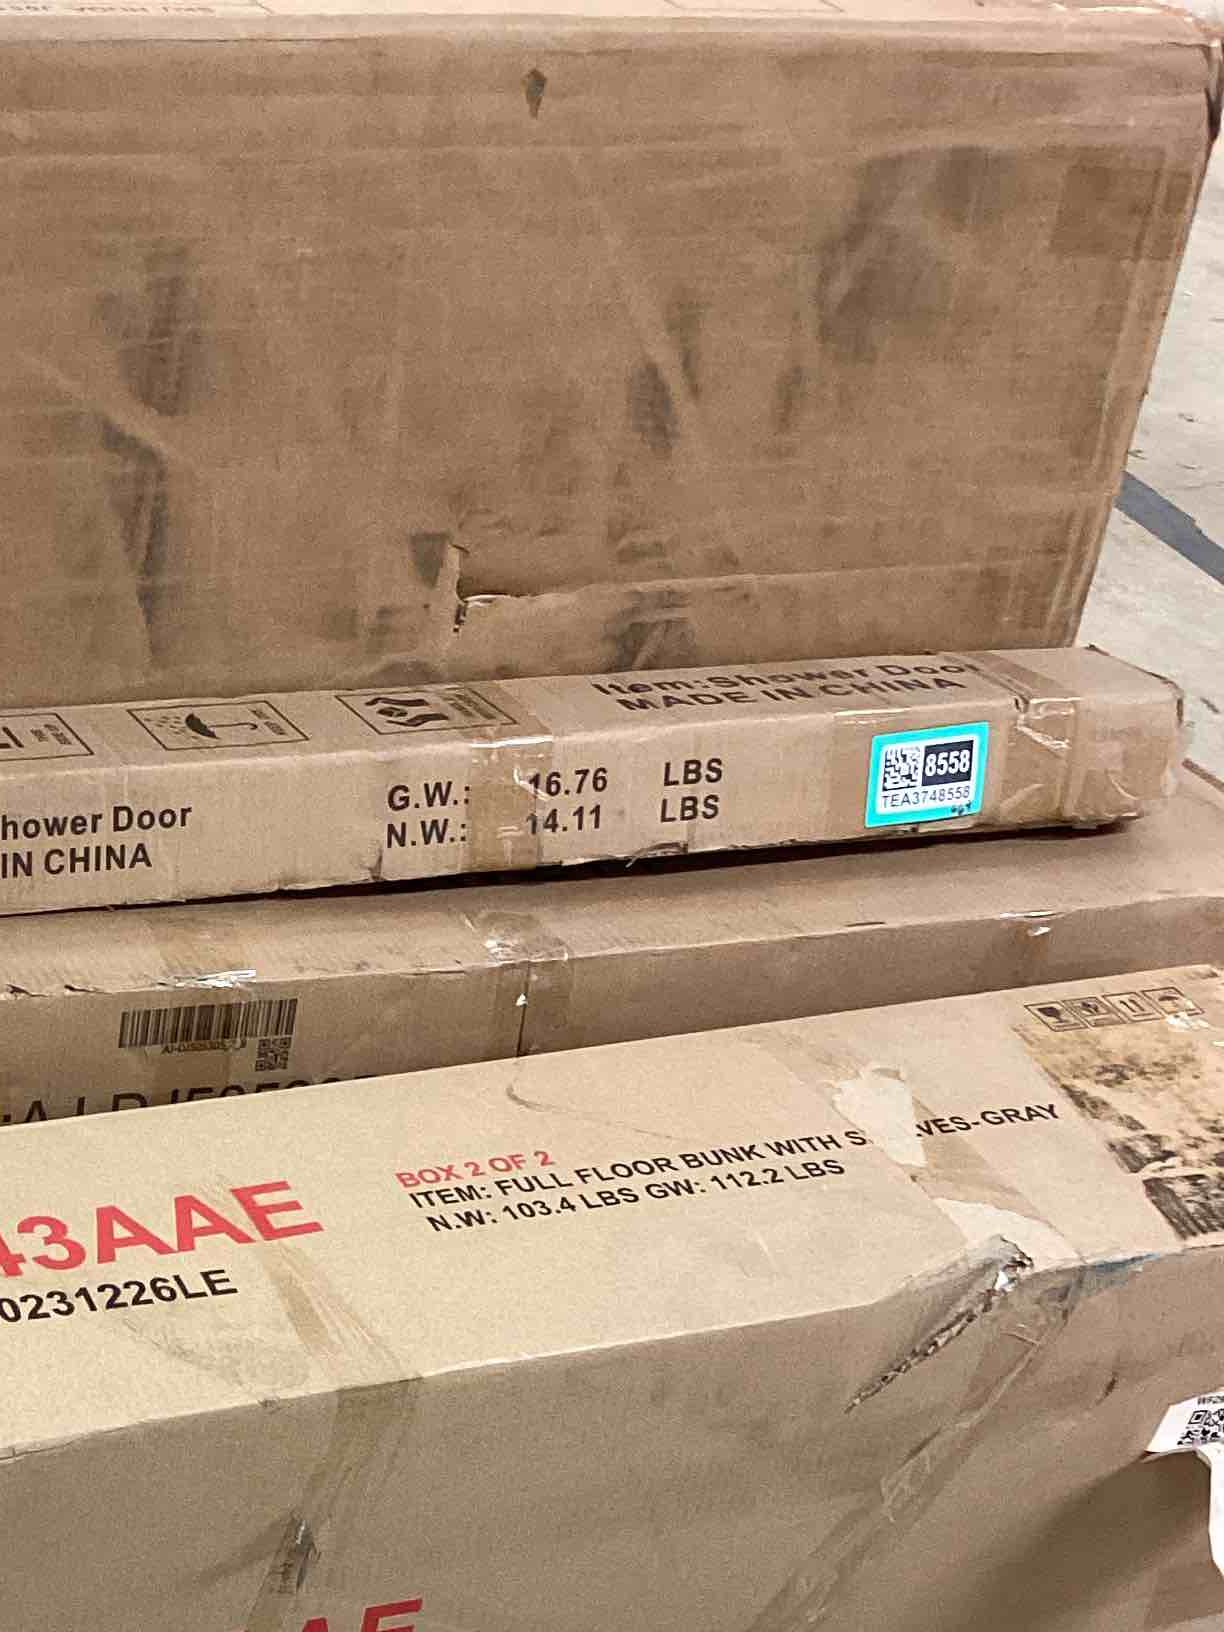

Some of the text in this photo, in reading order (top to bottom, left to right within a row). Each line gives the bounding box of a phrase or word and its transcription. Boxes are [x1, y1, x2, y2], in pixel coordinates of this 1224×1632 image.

[591, 667, 871, 697] Item:Shower
[616, 676, 968, 711] MADE IN CHINA
[924, 749, 971, 777] 8558
[387, 758, 724, 812] G.W.: 16.76 LBS
[881, 785, 971, 809] TEA3748558
[112, 805, 192, 833] Door
[386, 794, 721, 849] N.W.: 14.11 LBS
[0, 851, 33, 879] IN
[43, 842, 153, 876] CHINA
[395, 1150, 556, 1189] BOX 2 OF 2
[408, 1184, 492, 1209] ITEM:
[493, 1172, 574, 1196] FULL
[574, 1157, 680, 1184] FLOOR
[678, 1143, 766, 1169] BUNK
[764, 1133, 843, 1158] WITH
[426, 1158, 846, 1232] N.W: 103.4 LBS GW: 112.2 LBS
